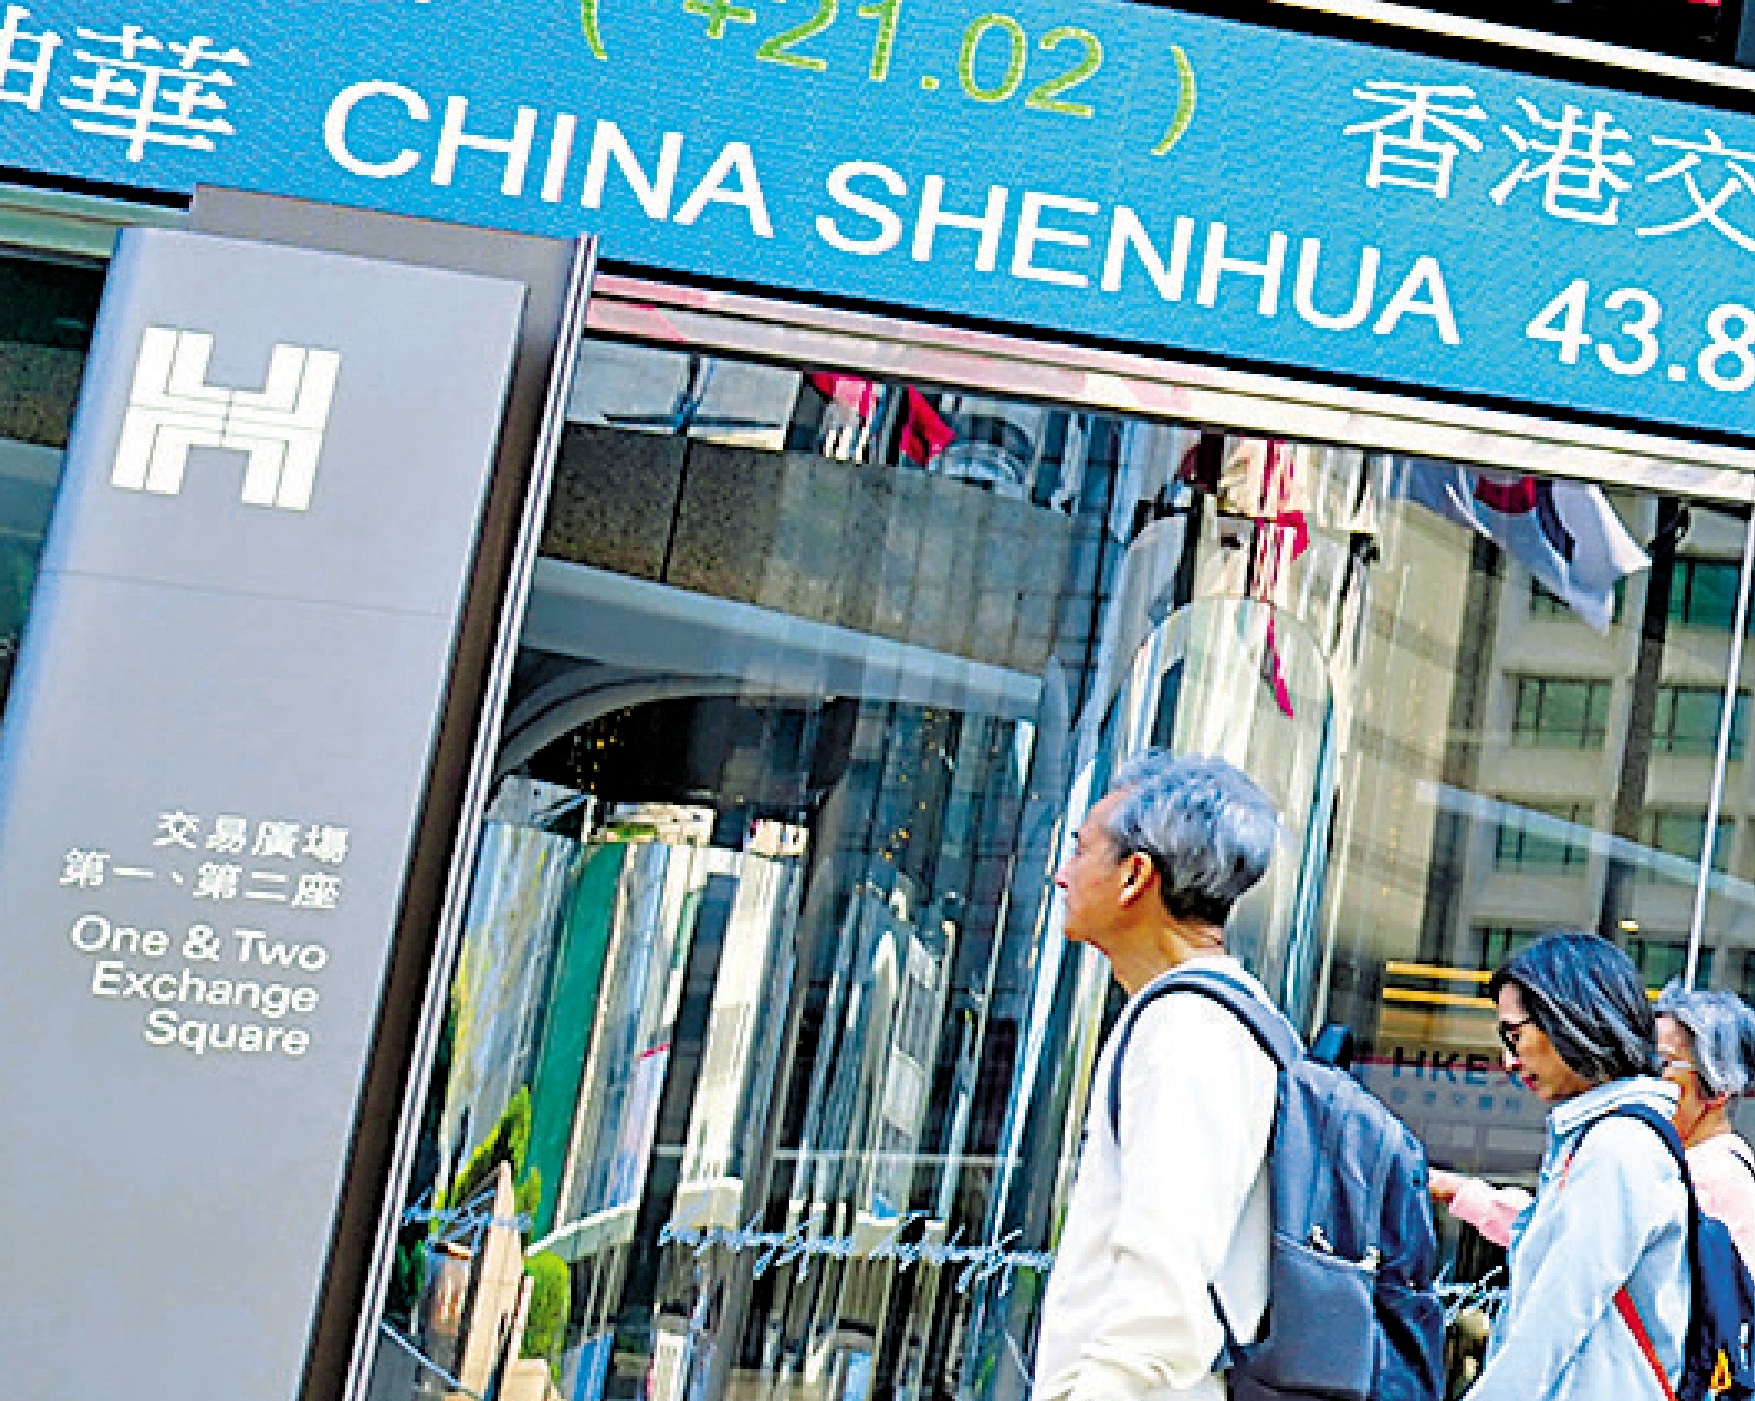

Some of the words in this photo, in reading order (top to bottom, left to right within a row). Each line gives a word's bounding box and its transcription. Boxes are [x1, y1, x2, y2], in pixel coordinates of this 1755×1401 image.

[323, 79, 774, 240] CHINA
[813, 158, 1461, 346] SHENHUA
[70, 913, 171, 957] One
[181, 923, 221, 962] &
[231, 928, 329, 970] Two
[91, 959, 321, 1018] Exchange
[143, 1007, 311, 1055] Square
